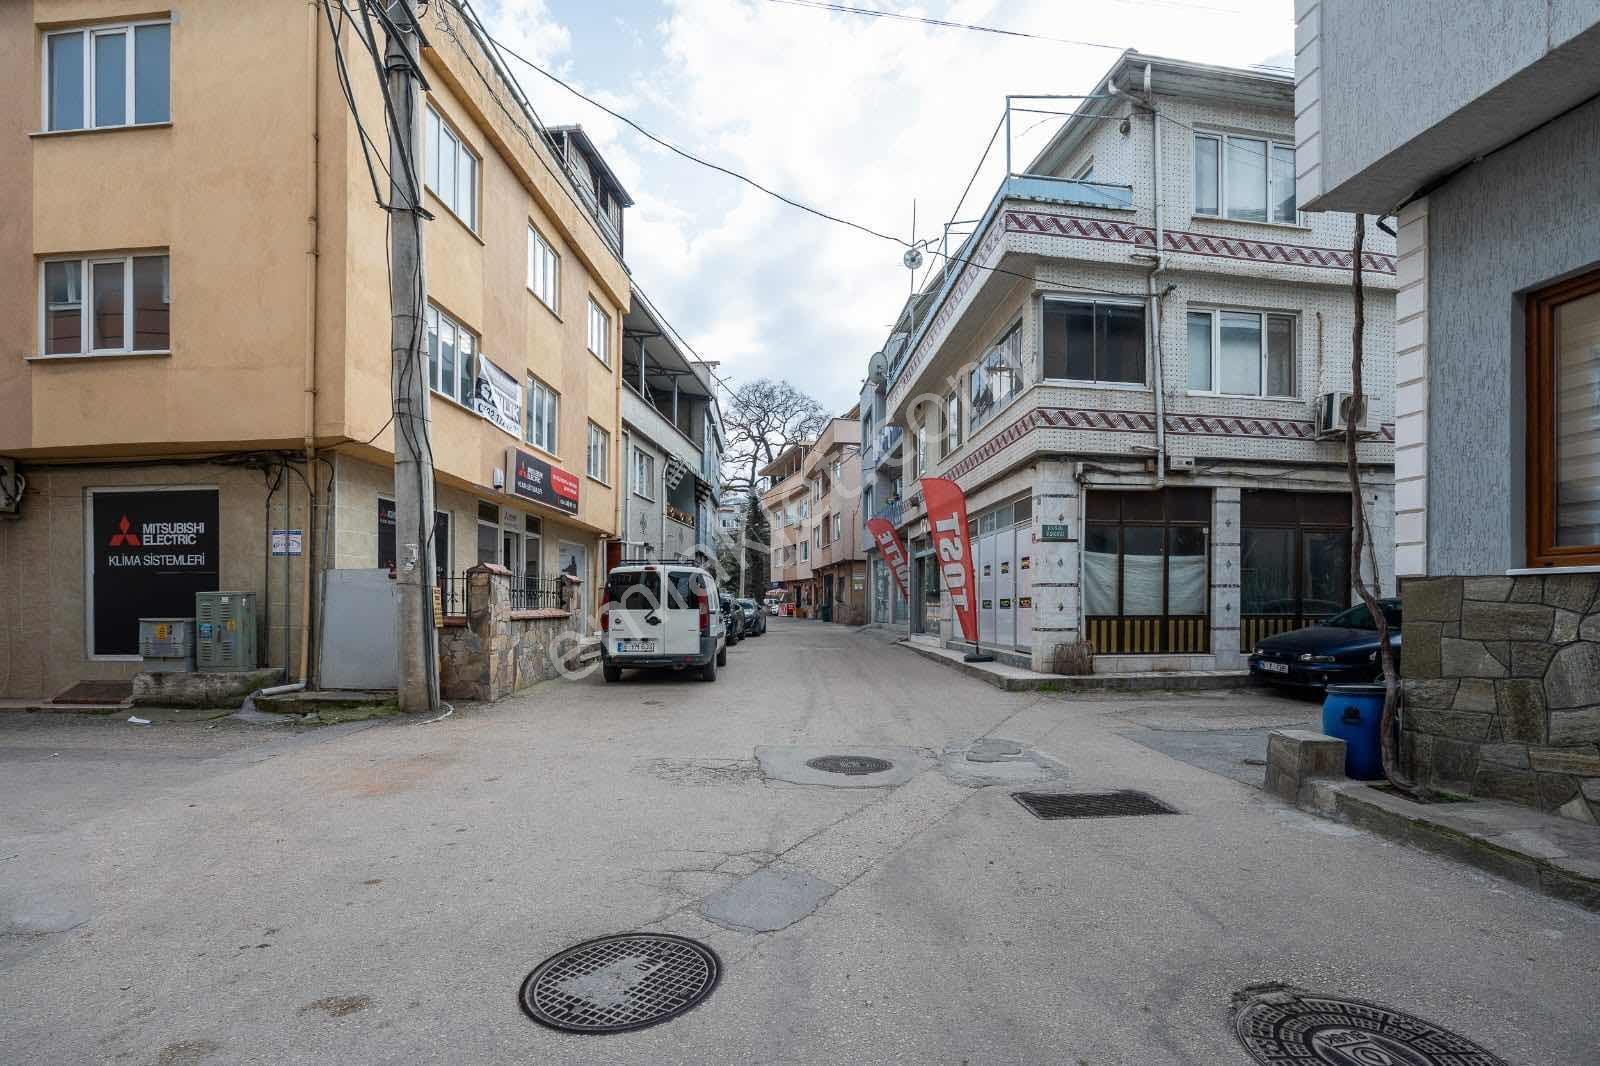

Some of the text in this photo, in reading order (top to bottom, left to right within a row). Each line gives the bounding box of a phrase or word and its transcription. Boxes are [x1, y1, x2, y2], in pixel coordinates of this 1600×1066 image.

[142, 522, 205, 534] MITSUBISHI
[142, 534, 197, 545] ELECTRIC
[108, 552, 205, 567] KLİMA SİSTEMLERİ
